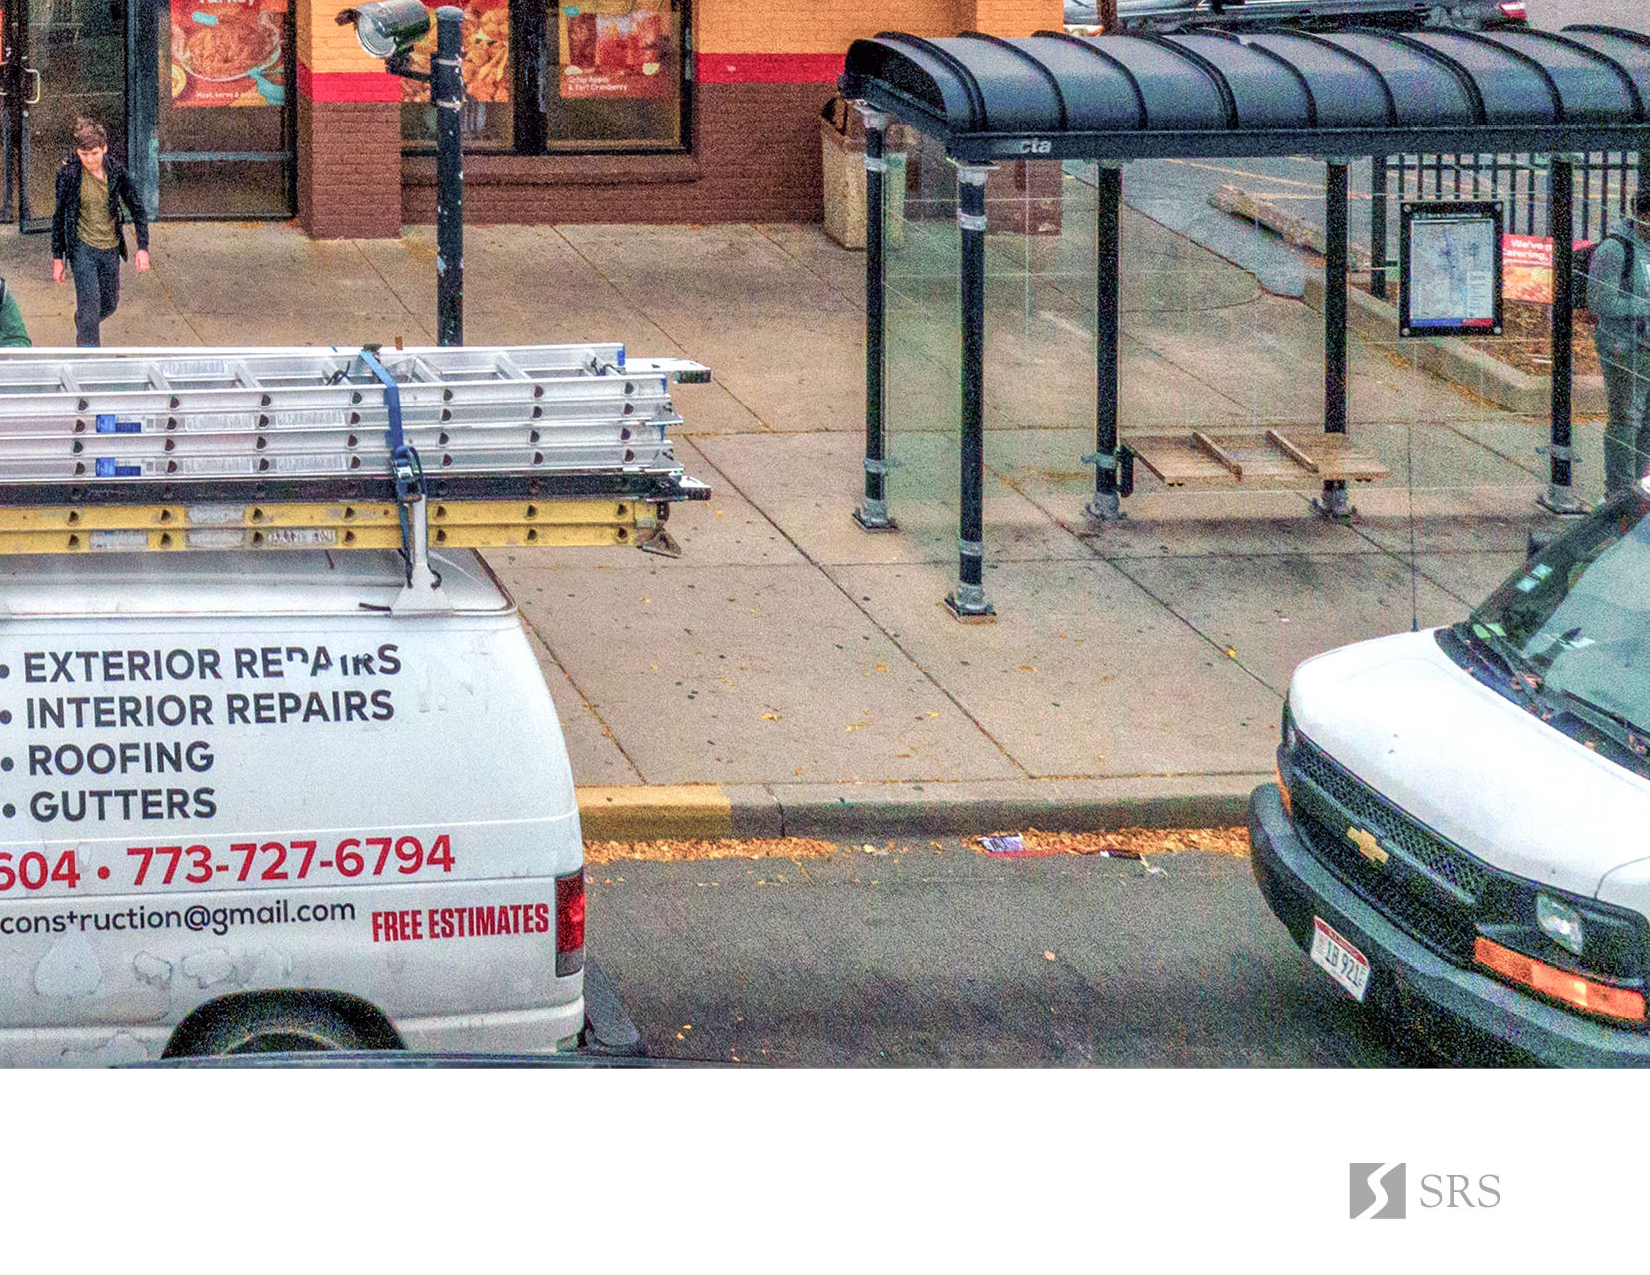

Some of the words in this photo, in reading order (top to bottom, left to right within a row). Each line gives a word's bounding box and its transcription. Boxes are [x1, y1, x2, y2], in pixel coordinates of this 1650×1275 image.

[1021, 137, 1052, 154] cta
[24, 648, 223, 682] EXTERIOR
[27, 694, 215, 729] INTERIOR
[227, 689, 395, 723] REPAIRS
[28, 741, 215, 776] ROOFING
[30, 787, 217, 823] GUTTERS
[127, 834, 456, 886] 773-727-6794
[371, 908, 423, 942] FREE
[428, 903, 549, 938] ESTIMATES
